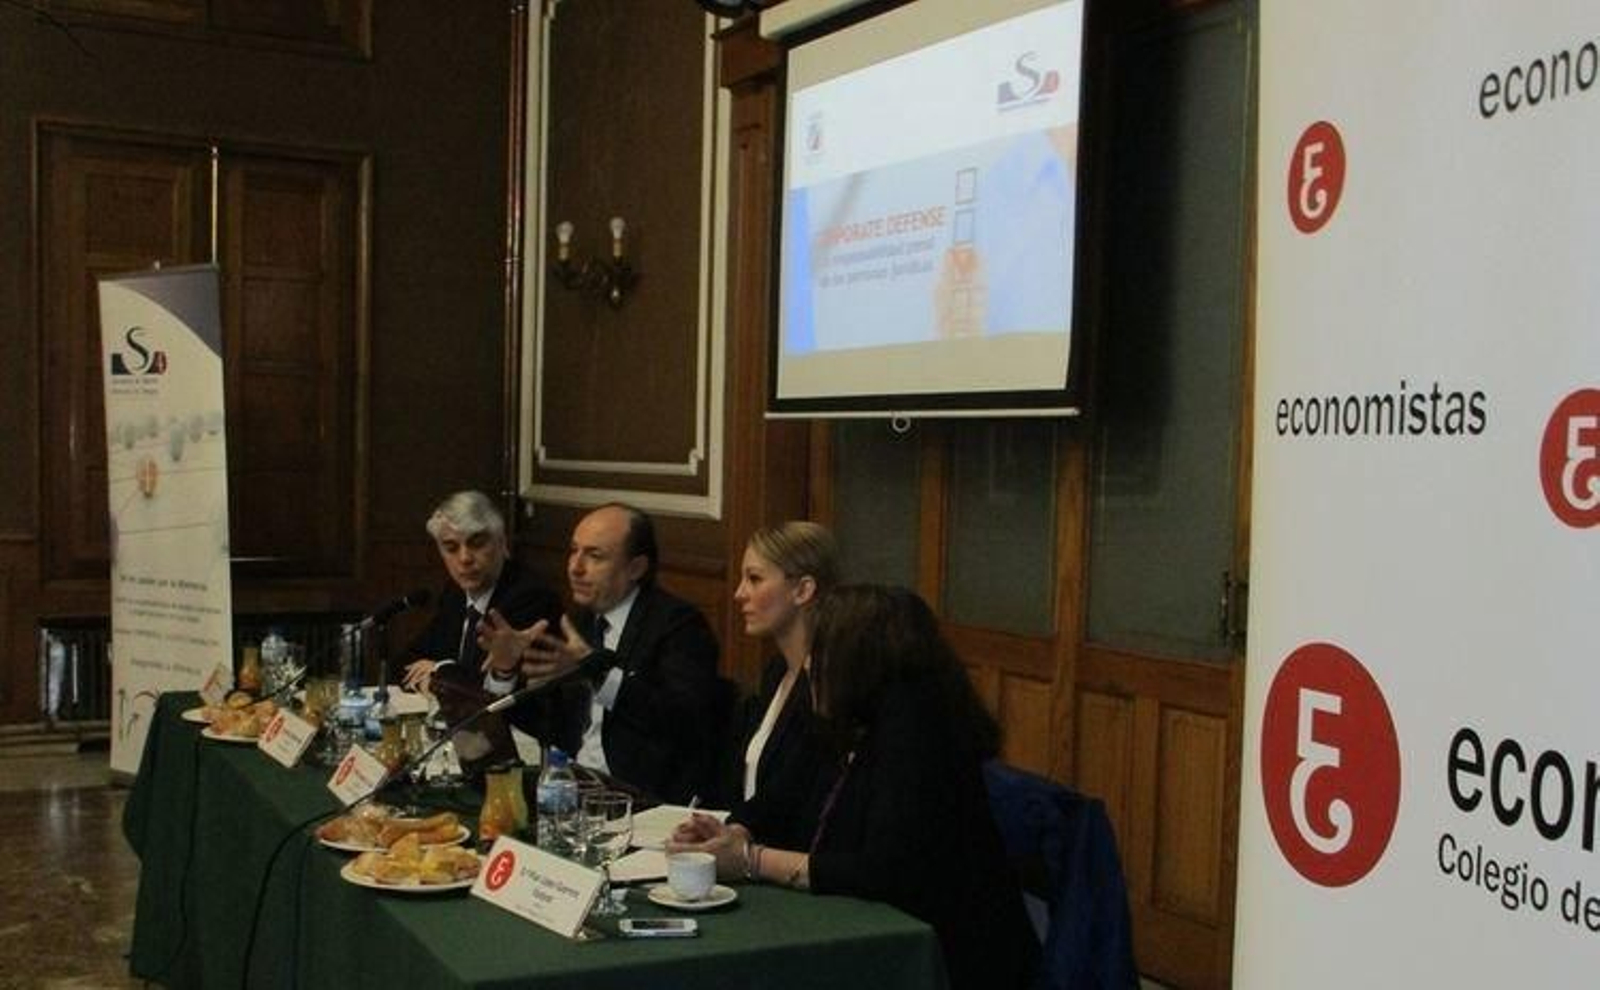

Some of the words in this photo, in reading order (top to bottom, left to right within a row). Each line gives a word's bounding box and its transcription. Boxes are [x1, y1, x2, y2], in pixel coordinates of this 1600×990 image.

[1479, 41, 1600, 119] econo
[1276, 380, 1487, 436] economistas
[1438, 833, 1549, 911] Colegio
[1561, 881, 1600, 933] de
